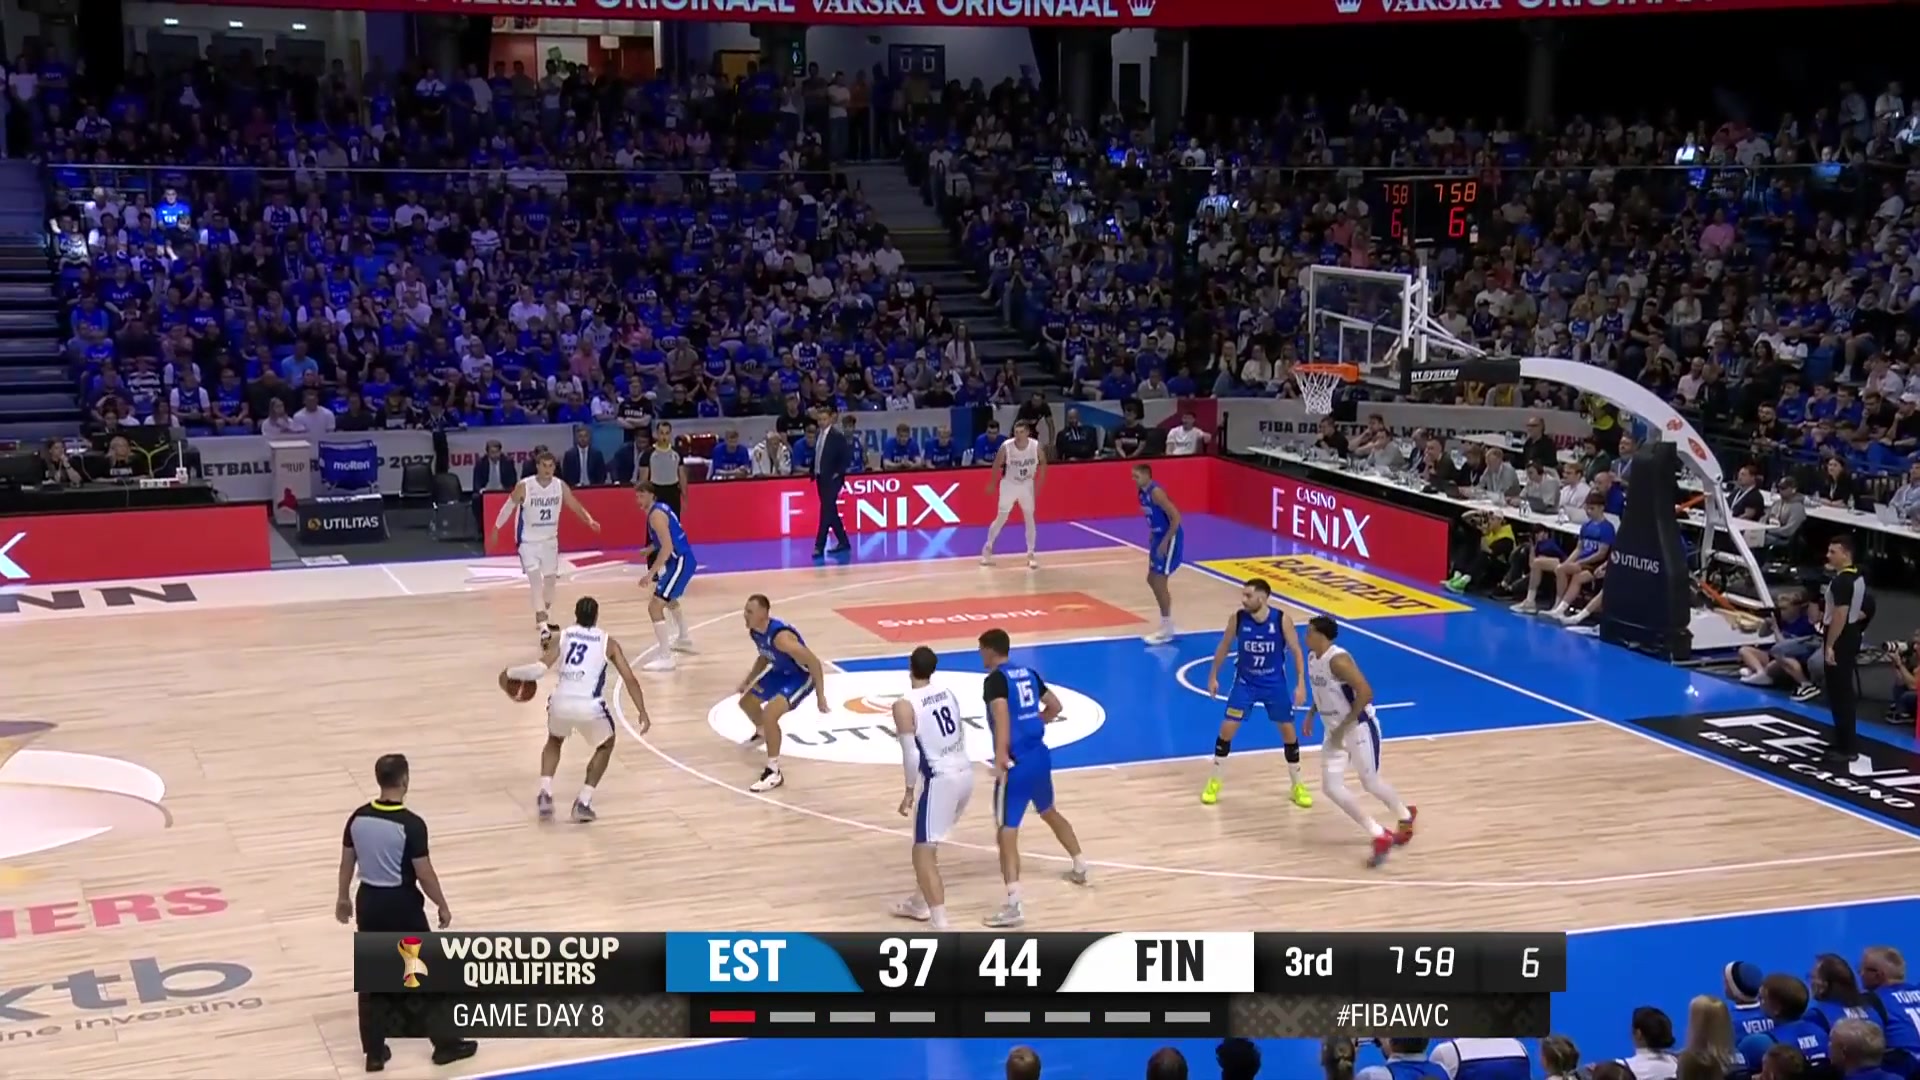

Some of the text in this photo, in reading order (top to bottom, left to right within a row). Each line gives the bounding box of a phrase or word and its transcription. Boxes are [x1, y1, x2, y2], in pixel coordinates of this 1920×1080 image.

[1448, 206, 1465, 237] 6
[1259, 420, 1293, 434] FIBA
[333, 459, 371, 471] molten
[1296, 486, 1337, 511] CASINO
[323, 516, 379, 530] UTILITAS
[540, 509, 552, 521] 23
[1271, 487, 1371, 559] FENIX
[1620, 553, 1660, 574] UTILITAS
[877, 608, 1048, 628] Swedbank
[565, 641, 588, 665] 13
[1244, 641, 1275, 653] EESTI
[1253, 657, 1265, 667] 77
[1015, 680, 1035, 708] 15
[932, 706, 956, 738] 18
[1698, 731, 1767, 752] BET
[1788, 763, 1916, 808] CASINO
[75, 996, 263, 1031] investing
